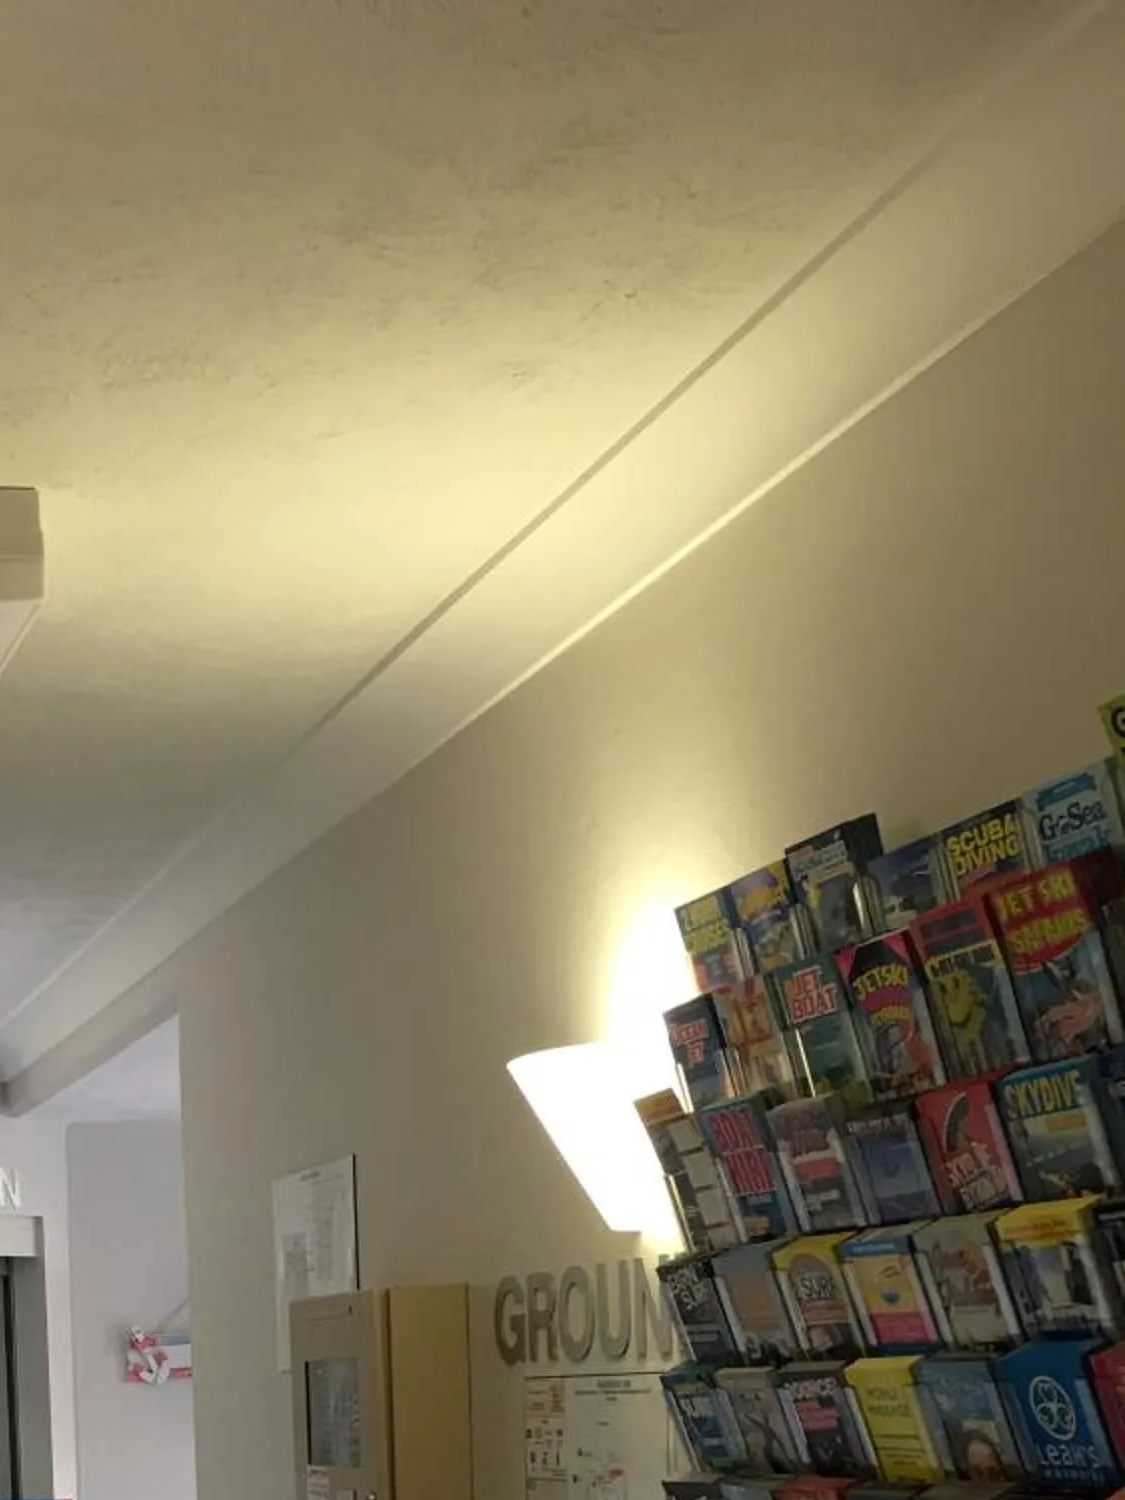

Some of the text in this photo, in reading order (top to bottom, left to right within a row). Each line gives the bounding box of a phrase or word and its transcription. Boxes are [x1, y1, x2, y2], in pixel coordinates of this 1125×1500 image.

[945, 812, 1020, 857] SCUBA
[953, 833, 1022, 877] DIVING
[997, 864, 1075, 921] JET SKI
